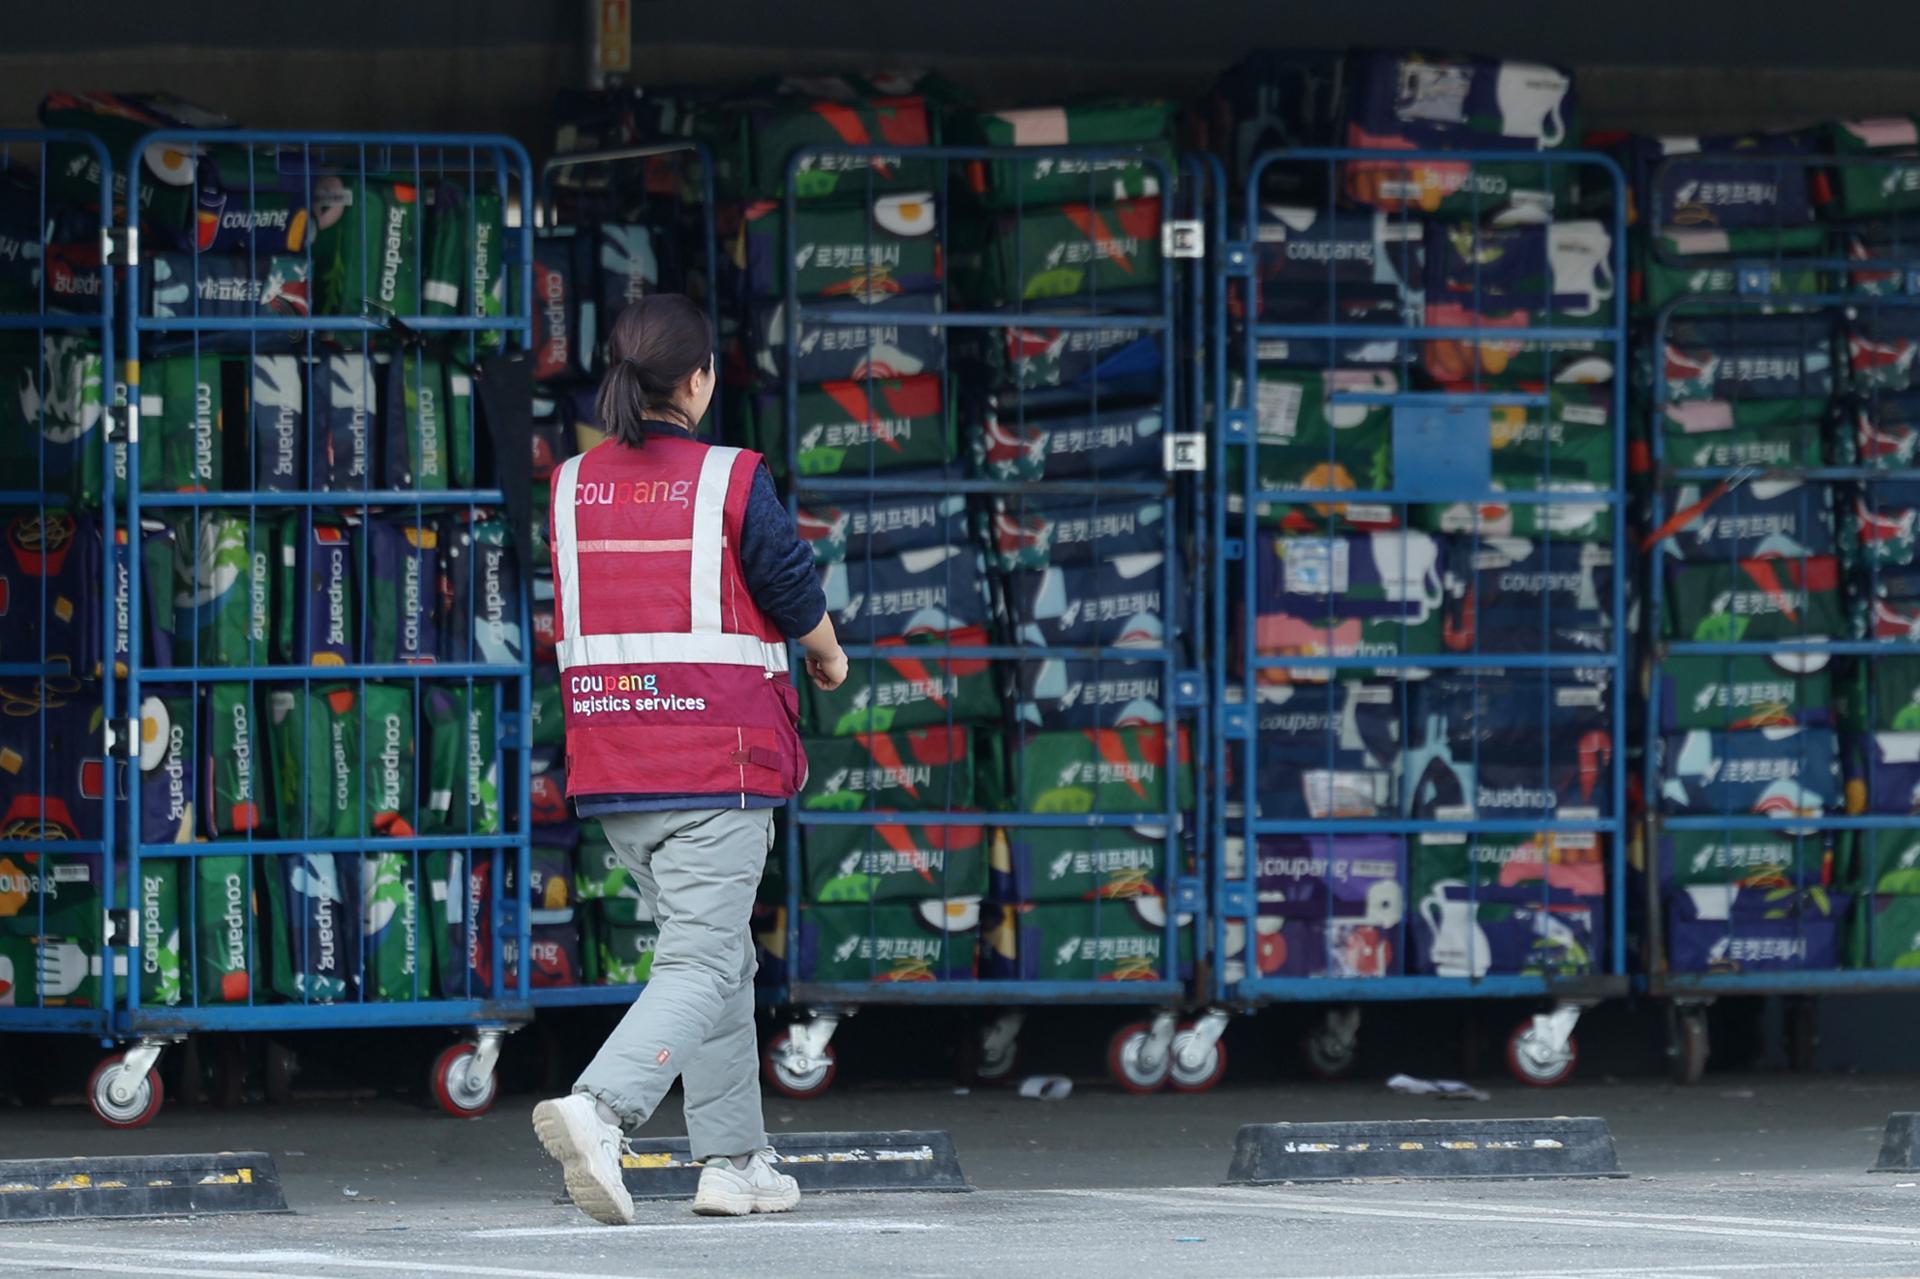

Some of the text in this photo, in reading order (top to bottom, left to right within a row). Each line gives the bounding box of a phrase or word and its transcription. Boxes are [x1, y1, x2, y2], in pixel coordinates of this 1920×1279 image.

[222, 209, 289, 232] coupang
[380, 206, 407, 302] coupang
[1286, 240, 1375, 266] coupang
[474, 223, 492, 319] coupang
[545, 270, 568, 364] coupang
[822, 324, 899, 351] 로켓프레시
[188, 382, 213, 481] coupang
[419, 386, 438, 477] coupang
[1051, 425, 1134, 454] 로켓프레시
[575, 479, 693, 510] coupang
[852, 504, 936, 535] 로켓프레시
[1055, 513, 1136, 543] 로켓프레시
[246, 552, 268, 642] coupang
[326, 549, 345, 646] coupang
[485, 551, 507, 644] coupang
[1499, 572, 1582, 599] coupang
[403, 555, 424, 651] coupang
[866, 586, 947, 617] 로켓프레시
[1082, 590, 1161, 622] 로켓프레시
[571, 673, 658, 697] coupang
[1082, 677, 1160, 705] 로켓프레시
[572, 694, 706, 717] logistics services
[1259, 711, 1344, 735] coupang
[232, 703, 250, 801] coupang
[332, 719, 351, 810] coupang
[379, 713, 402, 811] coupang
[165, 725, 185, 821] coupang
[849, 766, 931, 791] 로켓프레시
[1081, 762, 1155, 784] 로켓프레시
[1477, 784, 1558, 808] coupang
[862, 849, 945, 874] 로켓프레시
[1073, 847, 1155, 874] 로켓프레시
[0, 873, 58, 900] oupang
[144, 876, 164, 974] coupang
[224, 873, 246, 971] coupang
[860, 937, 942, 961] 로켓프레시
[1080, 936, 1161, 960] 로켓프레시
